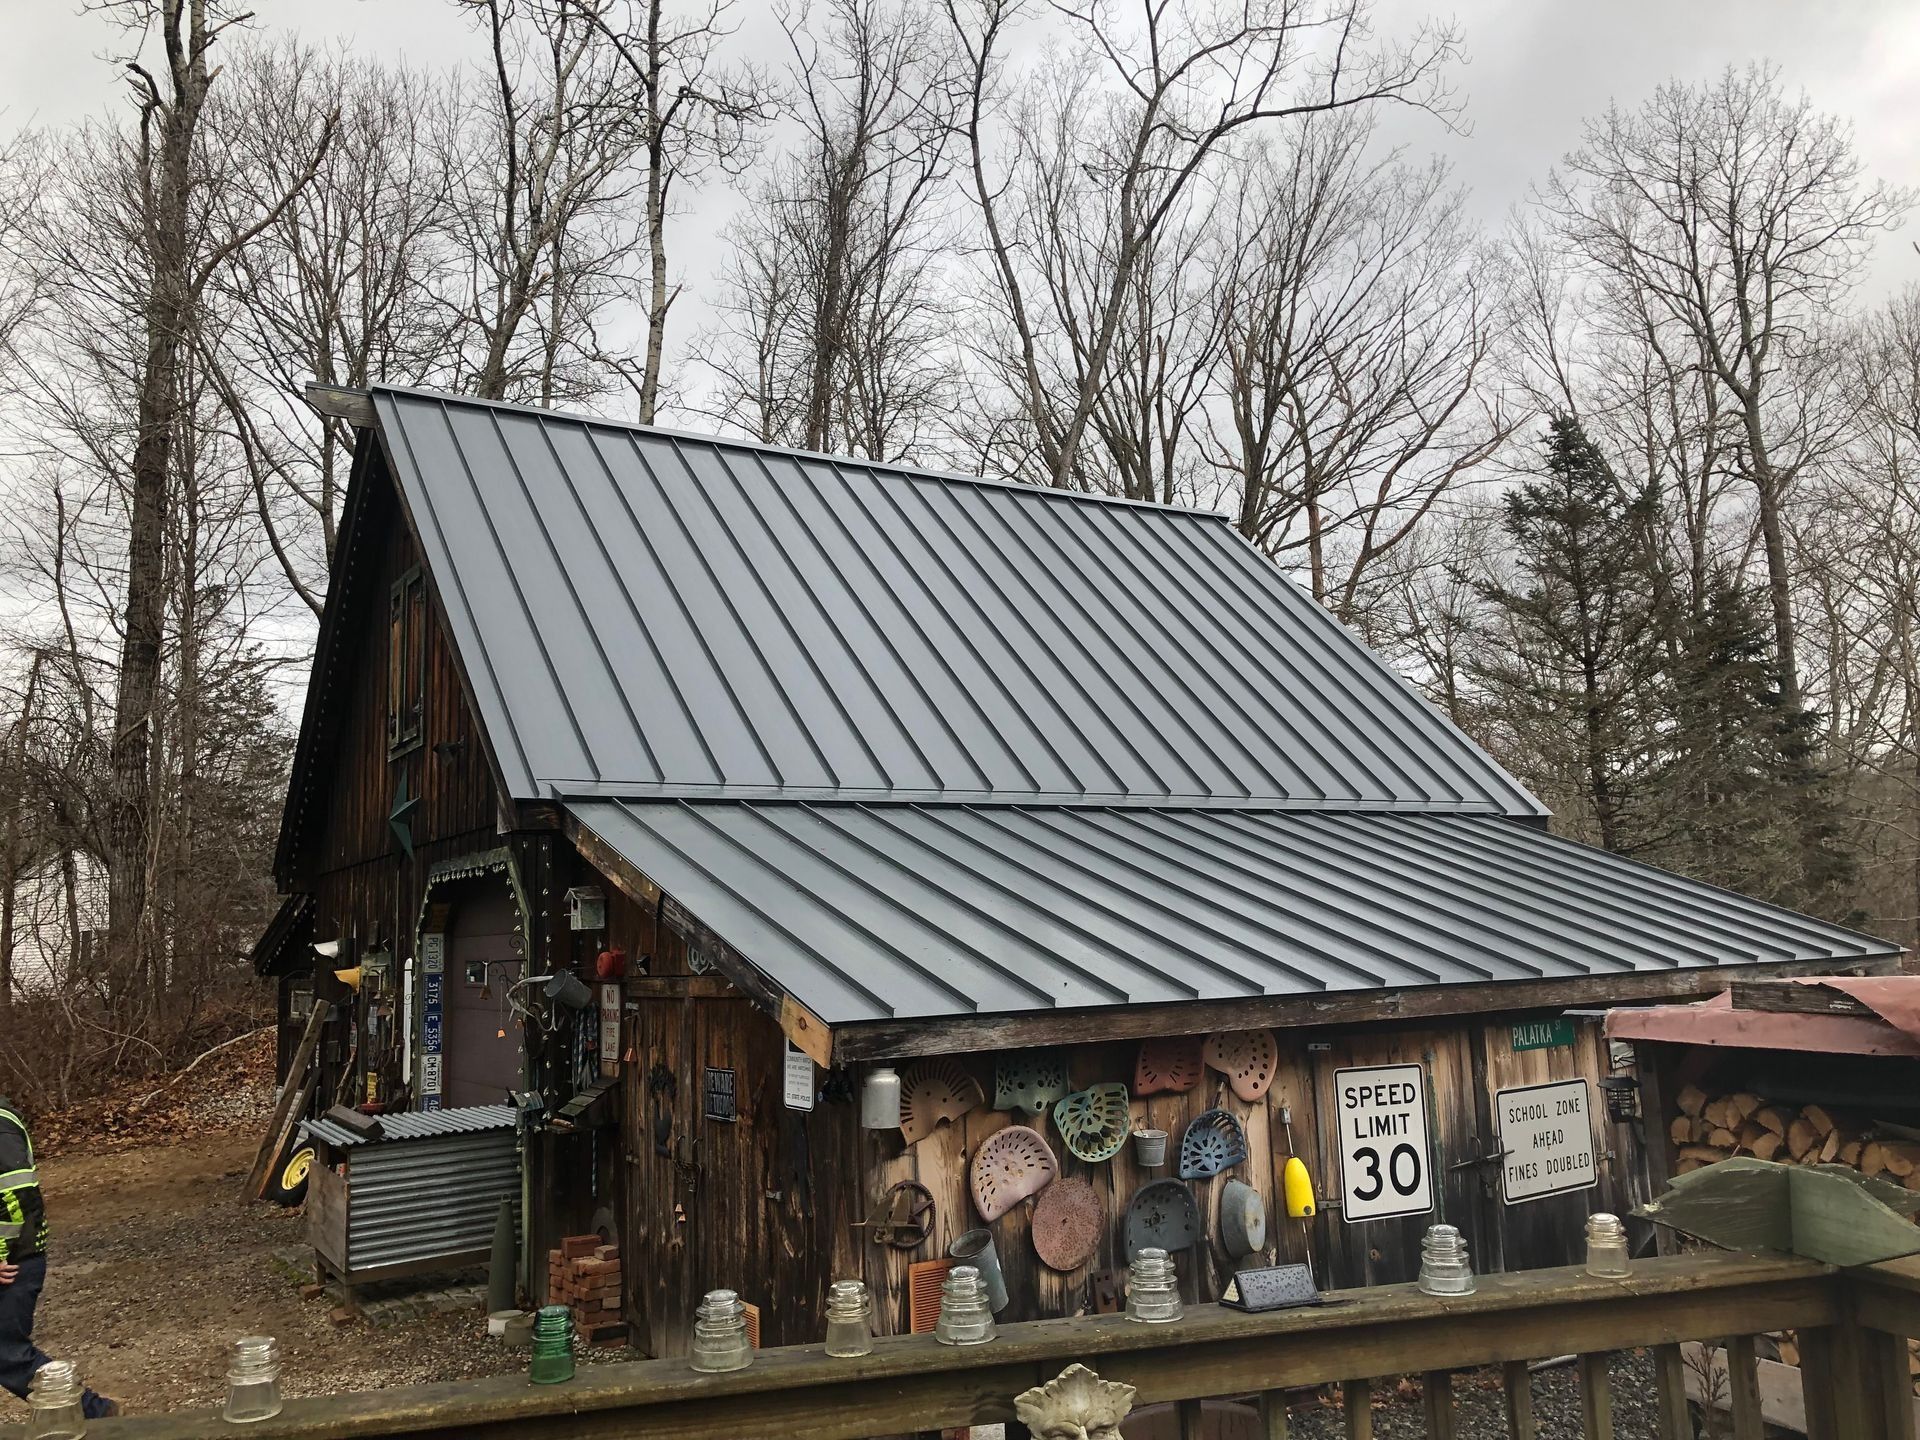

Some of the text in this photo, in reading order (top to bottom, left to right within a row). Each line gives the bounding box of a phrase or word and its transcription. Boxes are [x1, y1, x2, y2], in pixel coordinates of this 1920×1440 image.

[606, 989, 615, 1004] NO
[1512, 1024, 1553, 1047] PALATKA
[1345, 1083, 1416, 1109] SPEED
[1509, 1098, 1581, 1124] SCHOOL ZONE
[1354, 1113, 1410, 1139] LIMIT
[1533, 1129, 1564, 1149] AHEAD
[1352, 1143, 1421, 1201] 30
[1509, 1152, 1590, 1183] FINES DOUBLED
